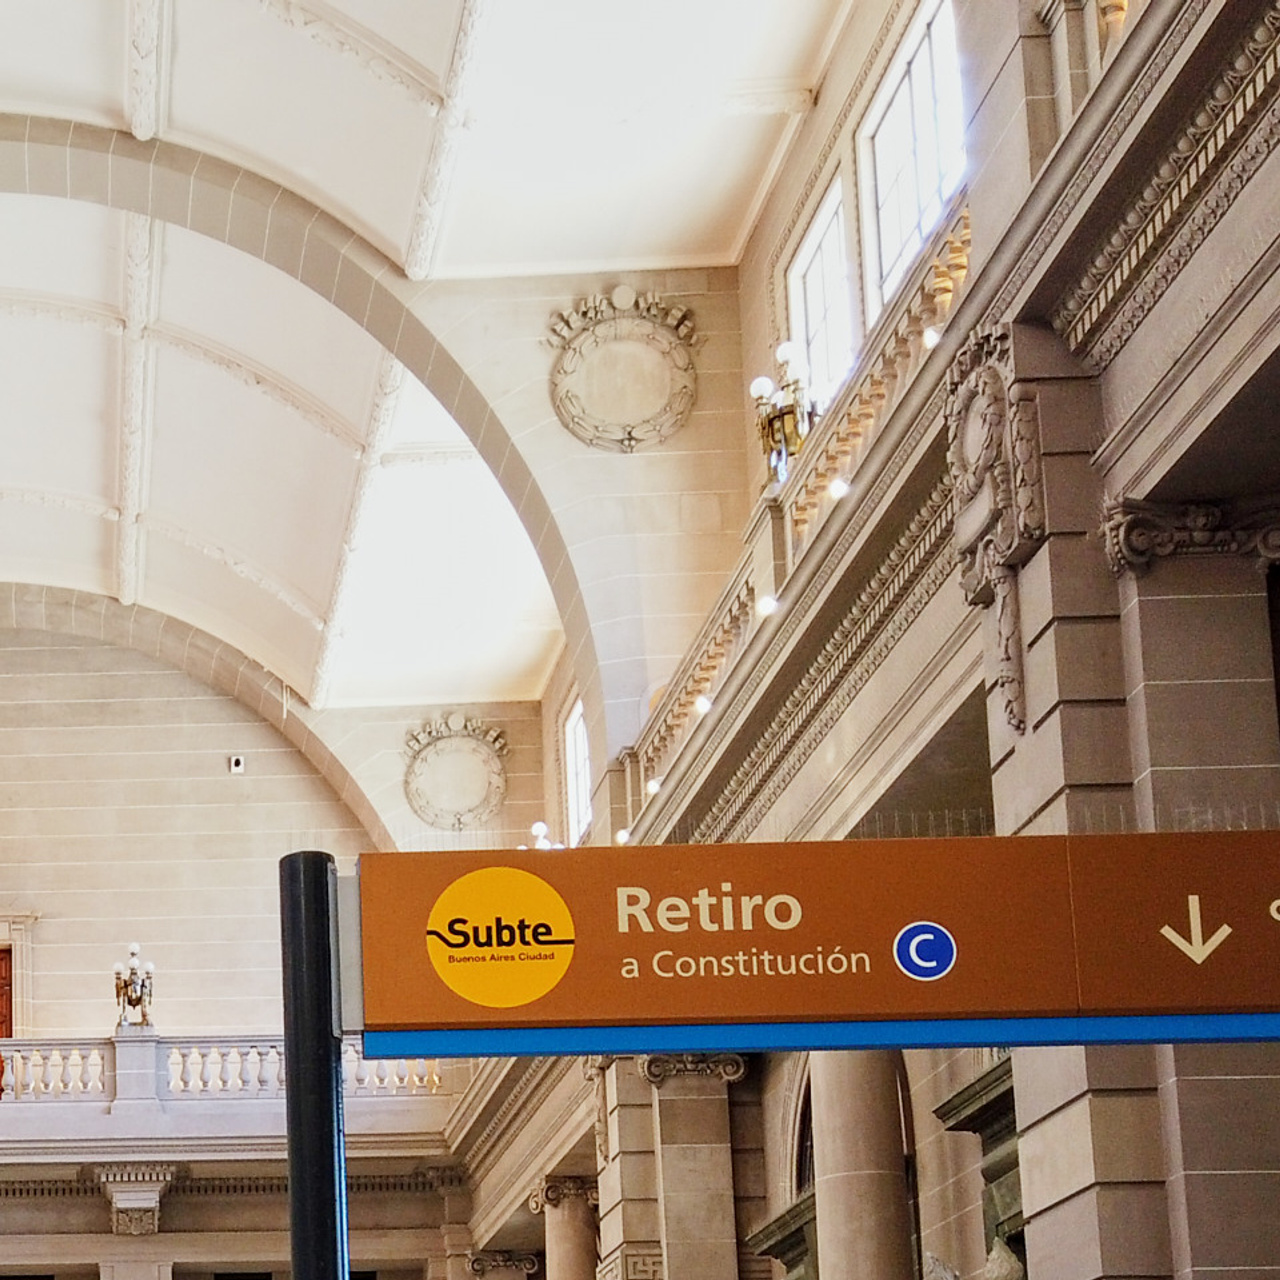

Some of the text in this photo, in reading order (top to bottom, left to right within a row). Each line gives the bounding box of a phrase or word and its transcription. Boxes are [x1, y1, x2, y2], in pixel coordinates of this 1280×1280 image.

[616, 882, 803, 933] Retiro
[446, 916, 556, 949] Subte
[448, 952, 555, 964] Buenos Aires Ciudad
[621, 945, 871, 979] a Constitución
[908, 932, 938, 968] C
